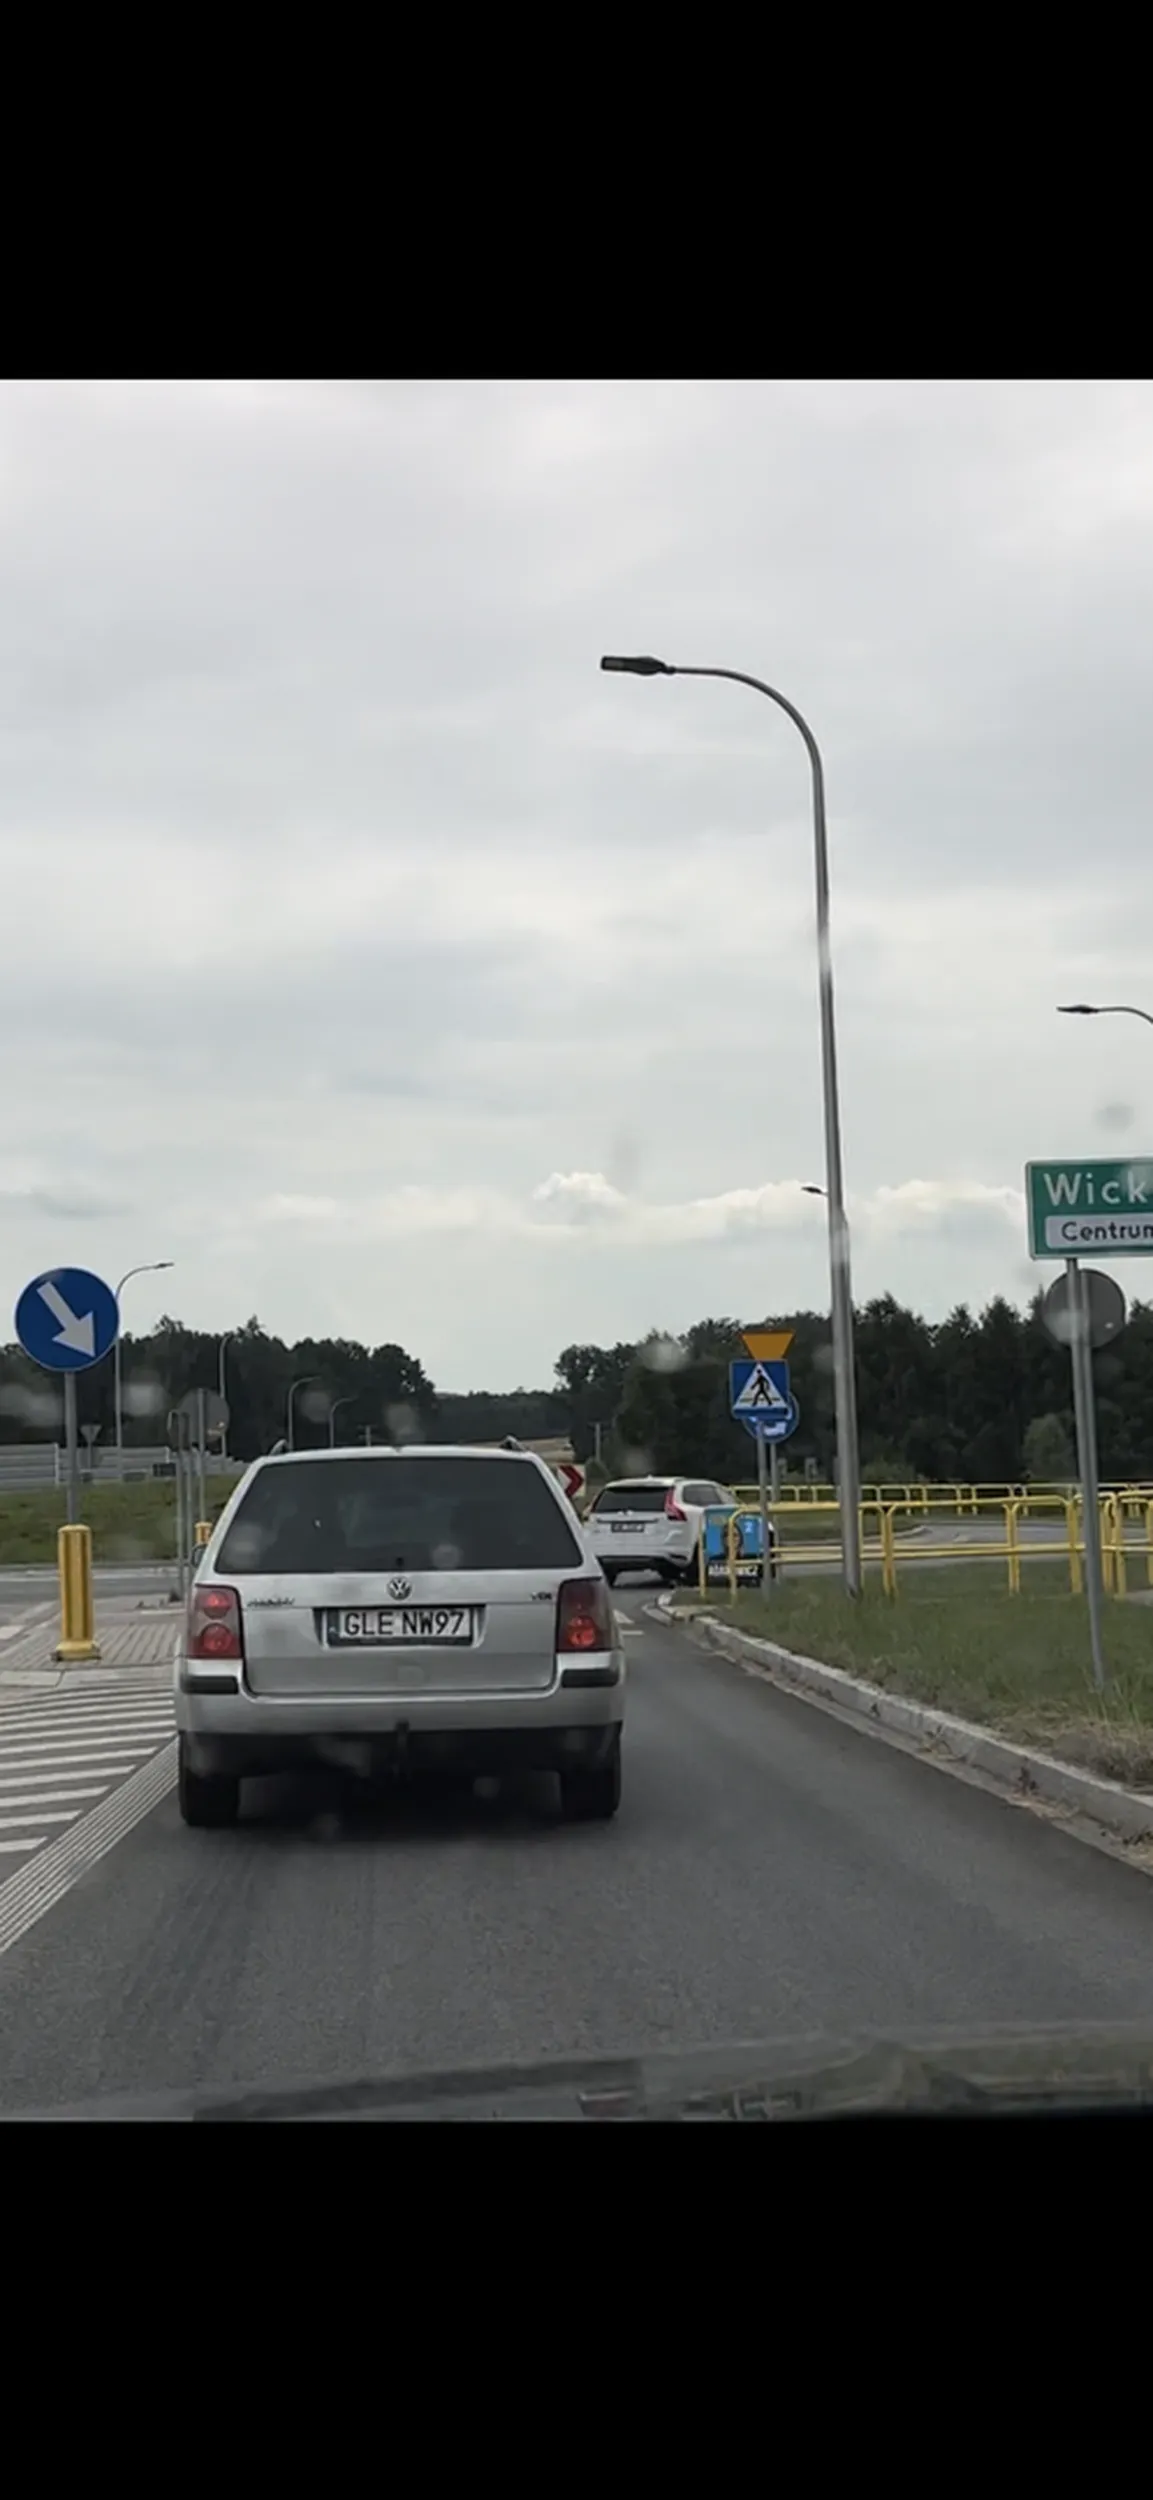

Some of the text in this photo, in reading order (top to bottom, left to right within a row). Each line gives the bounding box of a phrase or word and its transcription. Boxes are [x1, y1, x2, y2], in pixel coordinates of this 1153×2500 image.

[1043, 1171, 1148, 1206] Wick
[344, 1611, 465, 1636] GLE NW97
